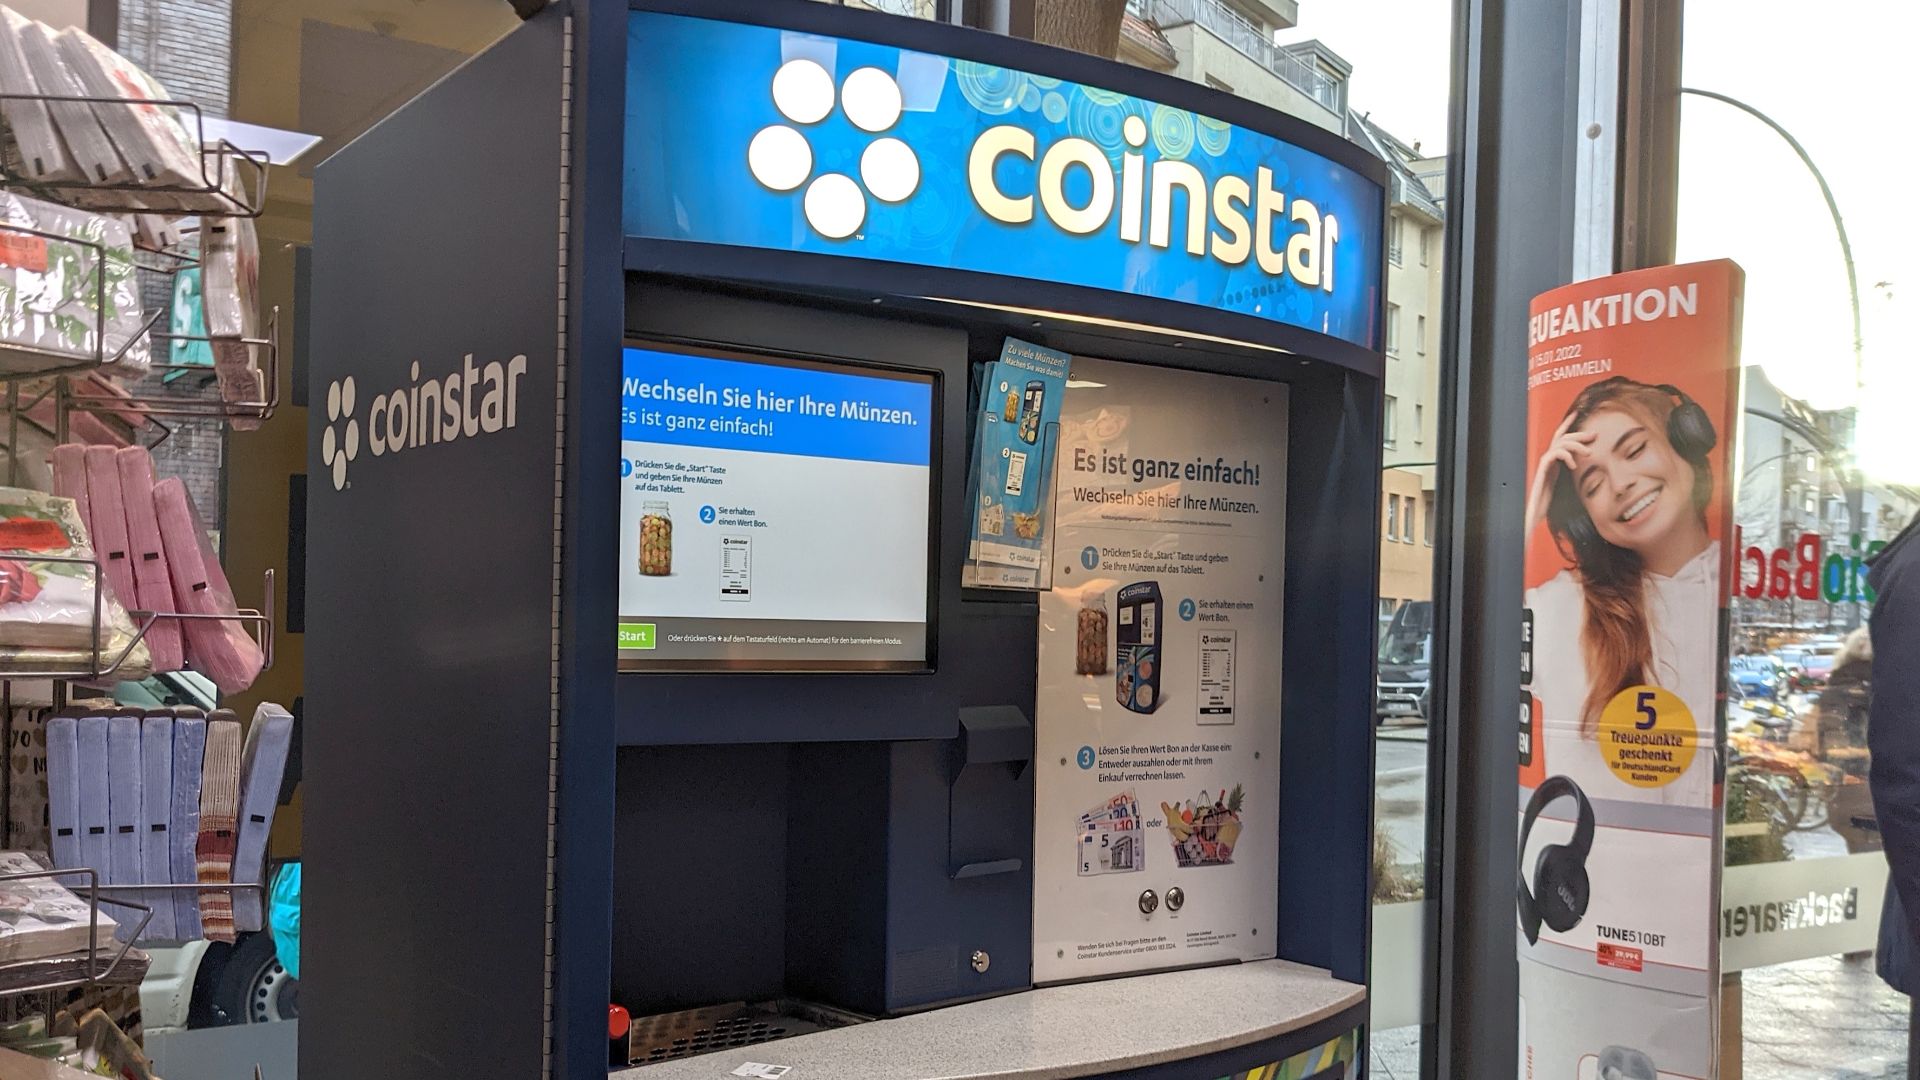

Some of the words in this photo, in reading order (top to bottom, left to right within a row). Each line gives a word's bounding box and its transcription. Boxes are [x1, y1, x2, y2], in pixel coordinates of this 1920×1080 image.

[968, 115, 1338, 292] coinstar
[1529, 283, 1697, 348] EUEAKTION
[1008, 345, 1017, 355] Zu
[1018, 348, 1034, 359] viele
[1035, 352, 1066, 367] Münzen?
[1005, 357, 1026, 369] Machen
[1035, 366, 1045, 374] was
[1552, 359, 1612, 381] SAMMELN
[369, 353, 527, 456] coinstar
[622, 377, 717, 405] Wechseln
[723, 388, 751, 408] Sie
[757, 389, 794, 412] hier
[800, 395, 836, 417] Ihre
[840, 401, 917, 425] Münzen.
[641, 408, 661, 426] ist
[666, 414, 706, 432] ganz
[709, 416, 773, 437] einfach!
[635, 460, 663, 470] Drücken
[664, 462, 674, 471] Sie
[675, 462, 686, 471] die
[709, 465, 726, 474] Taste
[1074, 448, 1096, 472] Es
[1102, 449, 1127, 475] ist
[1132, 457, 1180, 482] ganz
[1185, 457, 1260, 486] einfach!
[635, 472, 649, 480] und
[650, 473, 671, 482] geben
[671, 474, 682, 482] Sie
[682, 475, 696, 483] Ihre
[696, 476, 723, 485] Münzen
[635, 483, 647, 491] auf
[648, 484, 659, 492] das
[660, 484, 685, 493] Tablett.
[1073, 487, 1134, 506] Wechseln
[1137, 491, 1155, 506] Sie
[1158, 491, 1181, 508] hier
[1184, 495, 1206, 510] Ihre
[1209, 497, 1259, 514] Münzen.
[704, 509, 712, 520] 2
[719, 507, 728, 515] Sie
[729, 507, 755, 516] erhalten
[719, 518, 736, 526] einen
[737, 519, 753, 527] Wert
[1087, 551, 1093, 565] 1
[1102, 548, 1131, 558] Drücken
[1132, 549, 1141, 558] Sie
[1143, 550, 1153, 559] die
[1177, 552, 1193, 561] Taste
[1195, 553, 1208, 561] und
[1208, 553, 1229, 564] geben
[1102, 561, 1112, 570] Sie
[1113, 561, 1128, 571] Ihre
[1129, 562, 1155, 573] Münzen
[1156, 564, 1167, 573] auf
[1168, 564, 1179, 574] das
[1180, 565, 1205, 575] Tablett.
[1127, 585, 1152, 597] coinstar
[1184, 604, 1191, 617] 2
[1199, 600, 1207, 608] Sie
[1209, 600, 1236, 609] erhalten
[1199, 613, 1215, 621] Wert
[1216, 613, 1230, 622] Bon.
[619, 631, 646, 641] Start
[668, 634, 683, 642] Oder
[684, 634, 707, 642] drücken
[733, 635, 745, 643] dem
[746, 635, 778, 643] Tastaturfeld
[778, 636, 797, 644] (rechts
[831, 636, 839, 644] für
[1635, 692, 1657, 730] 5
[1611, 730, 1683, 747] Treuepunkte
[1098, 745, 1119, 755] Lösen
[1120, 745, 1129, 755] Sie
[1131, 744, 1149, 754] Ihren
[1150, 744, 1166, 754] Wert
[1167, 744, 1179, 753] Bon
[1181, 745, 1189, 753] an
[1190, 743, 1200, 752] der
[1202, 743, 1219, 752] Kasse
[1619, 749, 1672, 761] geschenkt
[1082, 750, 1090, 765] 3
[1098, 759, 1131, 769] Entweder
[1132, 757, 1165, 767] auszahlen
[1166, 757, 1181, 767] oder
[1182, 757, 1193, 766] mit
[1194, 756, 1213, 765] Ihrem
[1622, 761, 1681, 773] DeutschlandCard
[1098, 771, 1124, 783] Einkauf
[1125, 771, 1162, 781] verrechnen
[1163, 770, 1185, 779] lassen.
[1631, 773, 1658, 782] Kunden
[1146, 818, 1162, 828] oder
[1101, 834, 1109, 848] 5
[1084, 862, 1089, 872] 5
[1596, 924, 1666, 947] TUNE510BT
